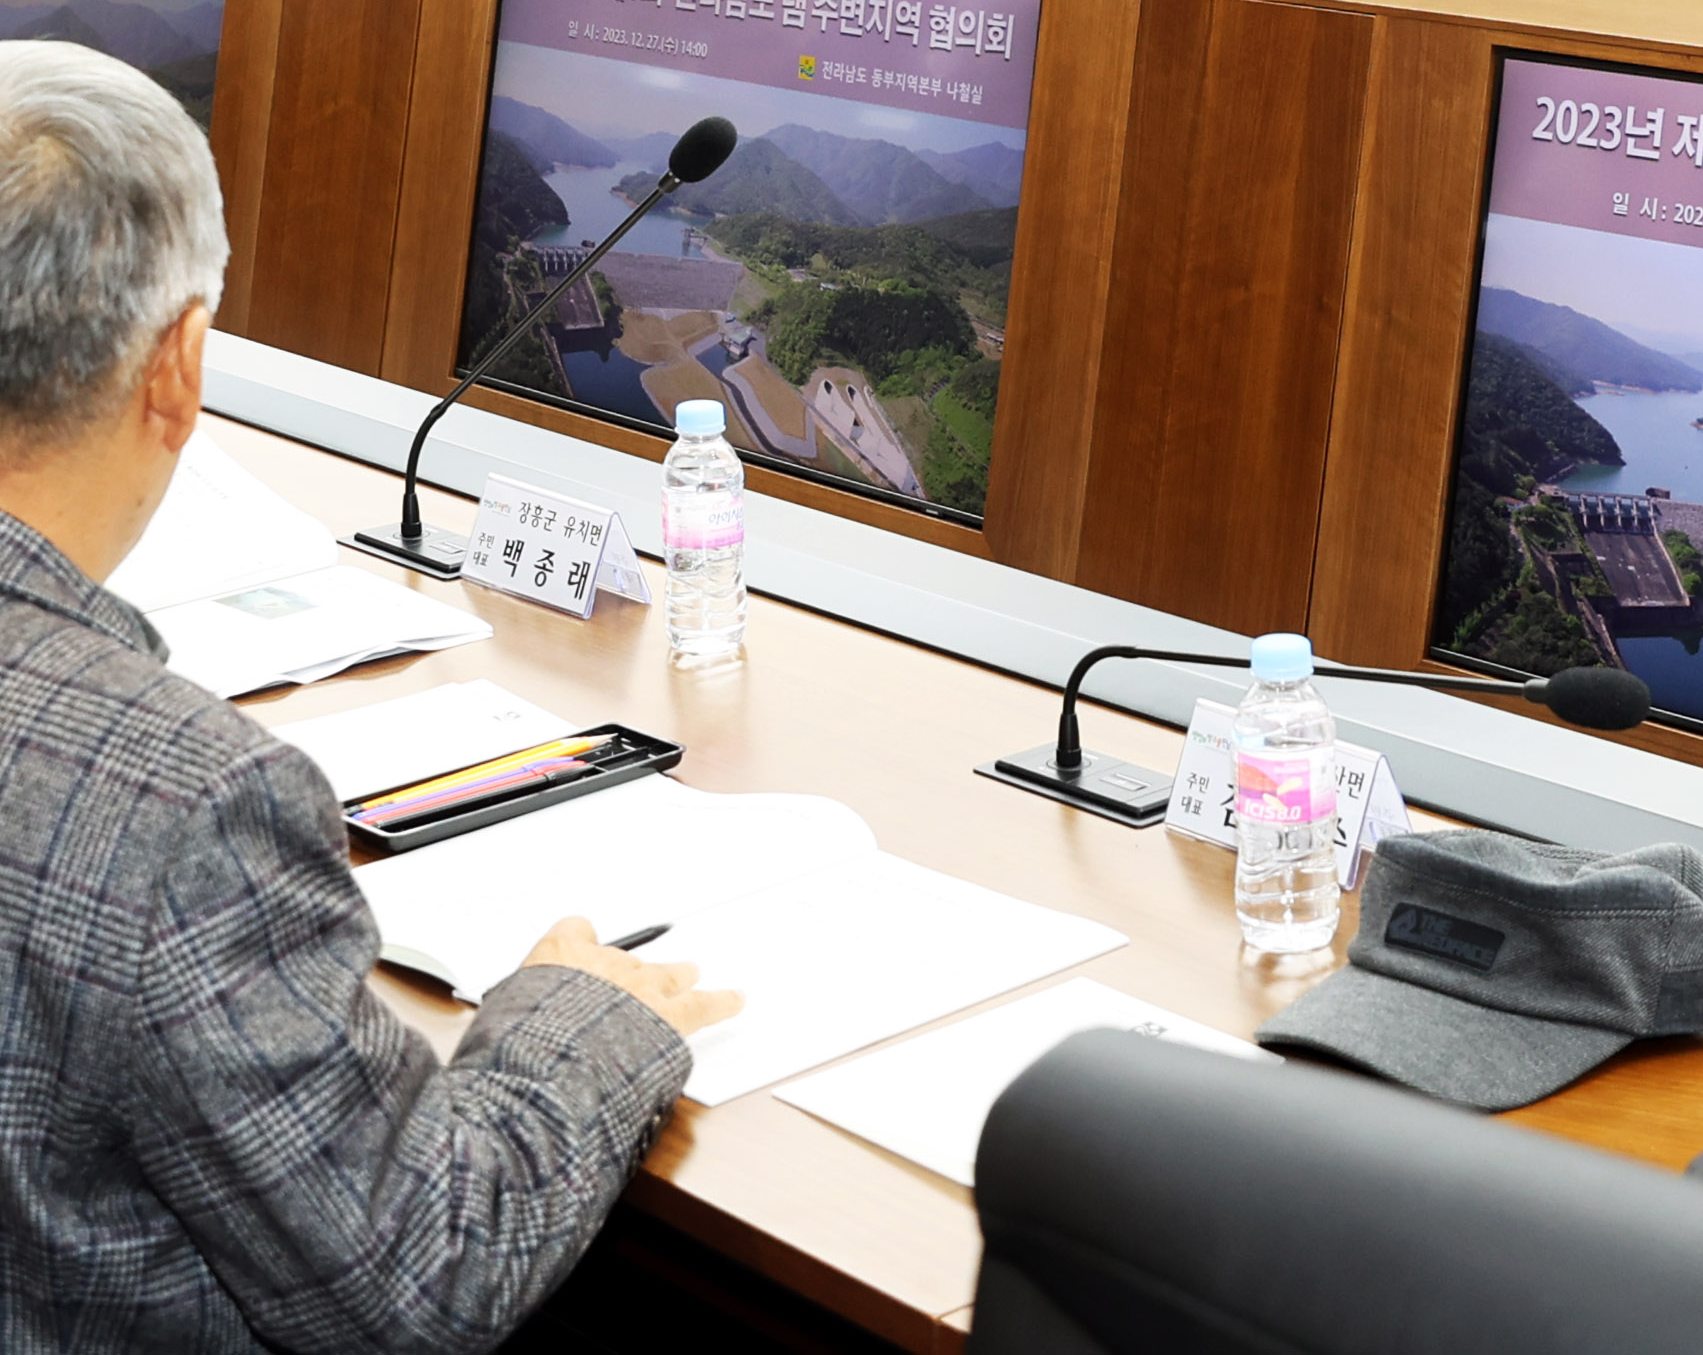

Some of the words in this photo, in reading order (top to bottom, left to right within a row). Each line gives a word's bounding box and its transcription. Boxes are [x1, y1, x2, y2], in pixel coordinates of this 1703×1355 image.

[602, 25, 629, 46] 2023.
[630, 30, 646, 50] 12.
[680, 39, 708, 60] 14:00
[928, 5, 1016, 61] 협의회
[821, 60, 868, 86] 전라남도
[871, 66, 943, 99] 동부지역본부
[946, 77, 984, 106] 나철실
[1529, 94, 1662, 162] 2023년
[478, 532, 495, 549] 주민
[518, 501, 558, 532] 장흥군
[563, 516, 603, 547] 유치면
[472, 550, 489, 567] 대표
[1187, 772, 1210, 792] 주민
[1181, 795, 1203, 816] 대표
